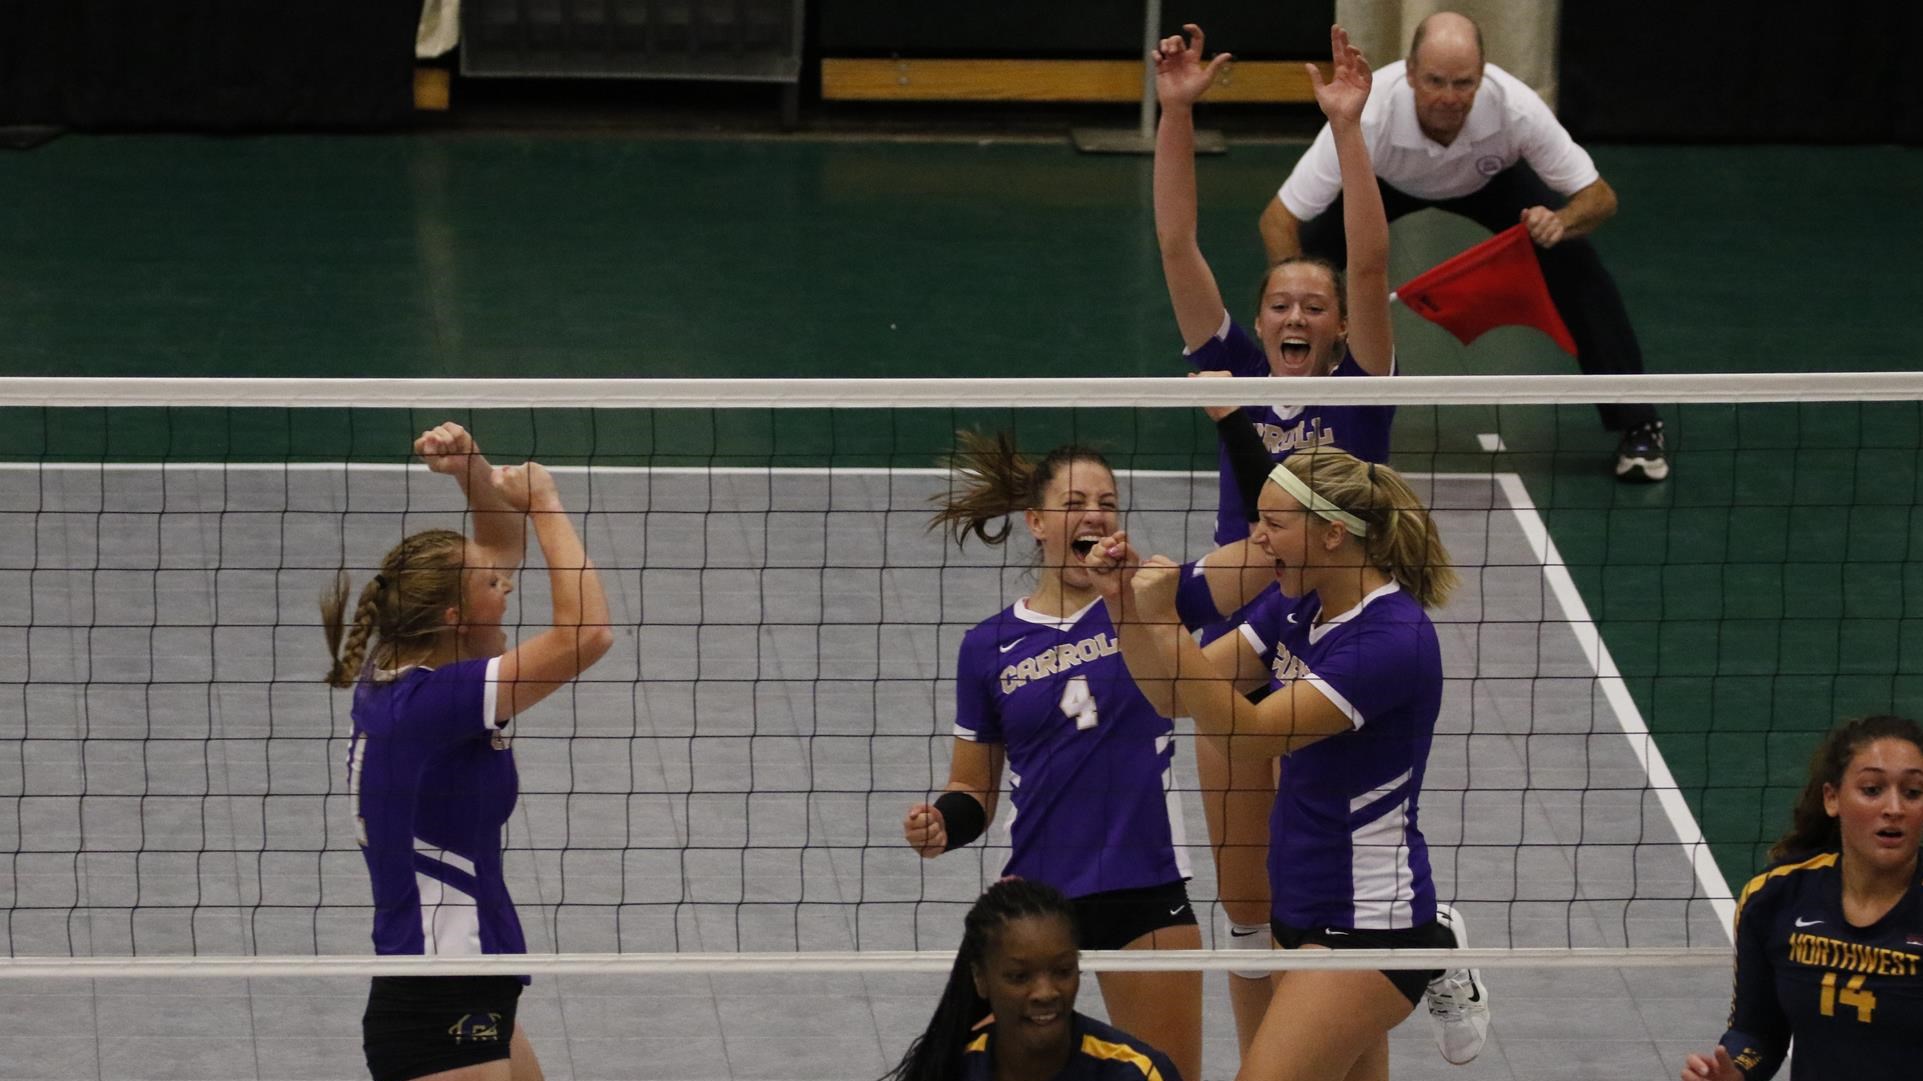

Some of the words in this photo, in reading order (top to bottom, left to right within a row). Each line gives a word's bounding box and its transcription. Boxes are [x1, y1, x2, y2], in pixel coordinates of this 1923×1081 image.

[1253, 416, 1335, 454] ROLL
[1000, 632, 1120, 695] CARROL
[1059, 674, 1099, 731] 4
[1789, 932, 1920, 976] NORTHWEST
[1819, 971, 1877, 1024] 14
